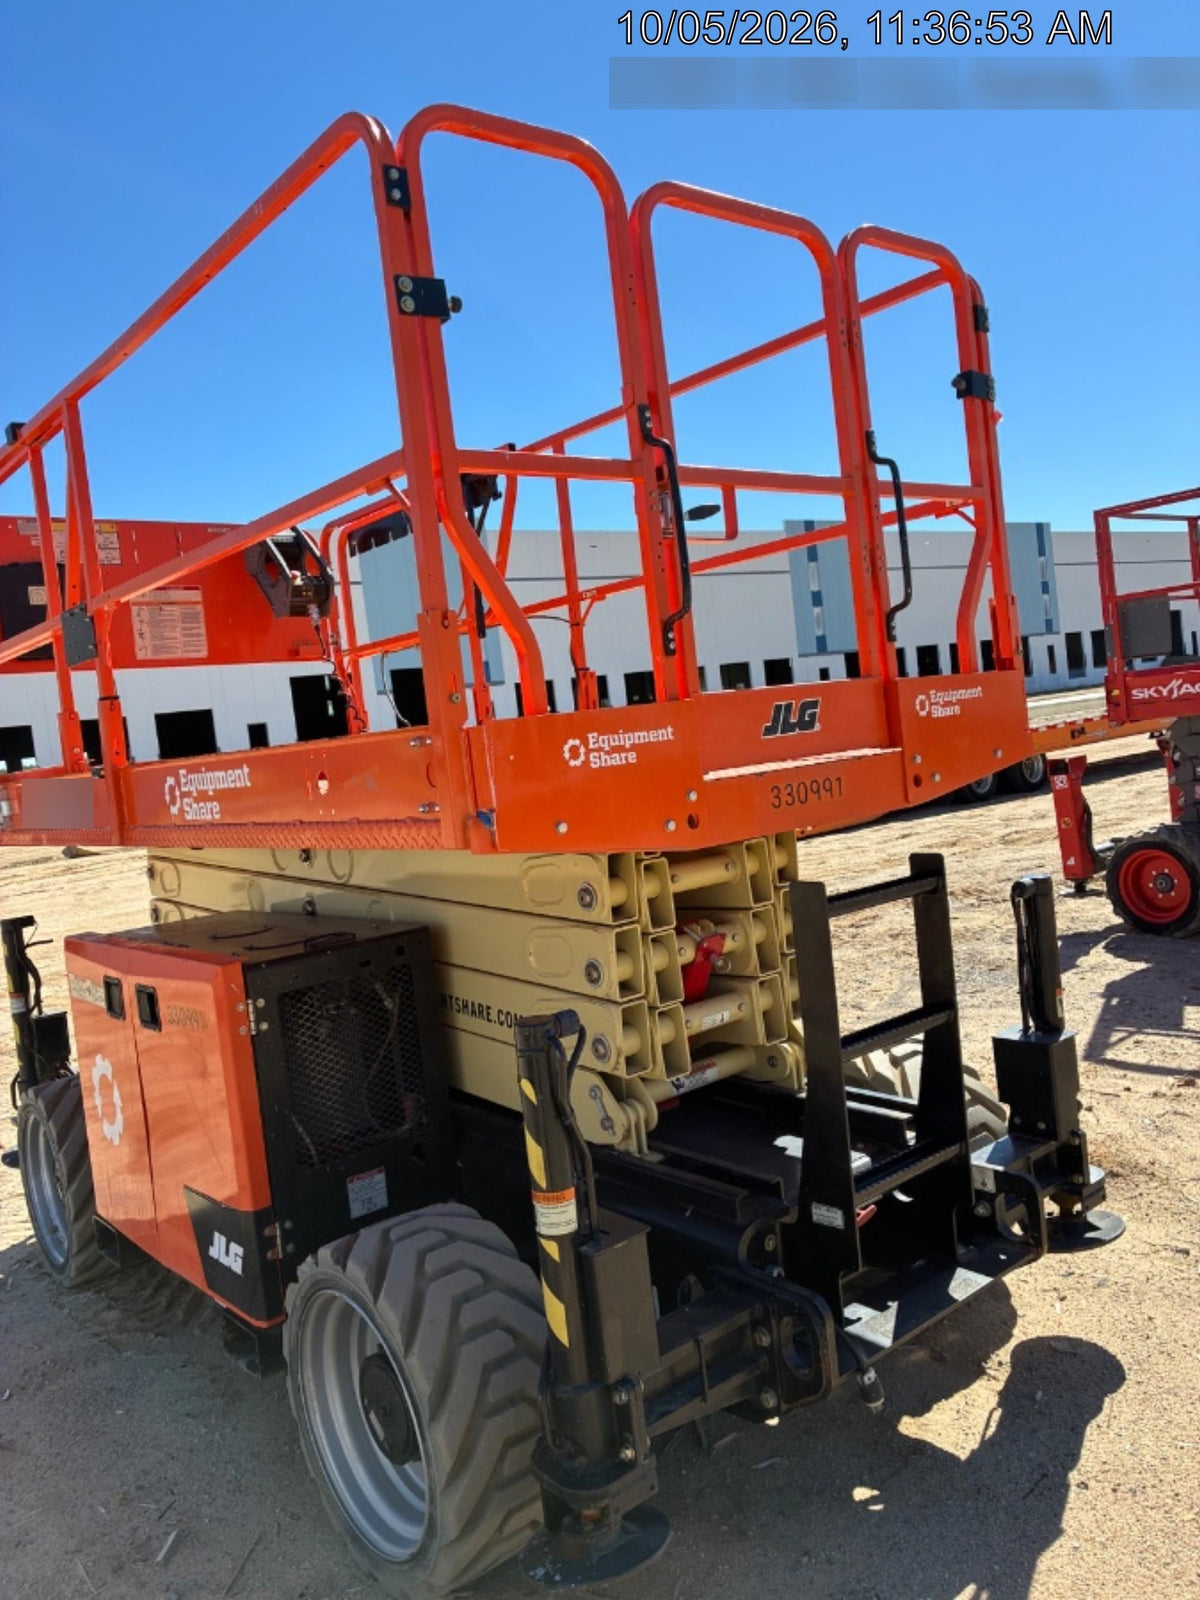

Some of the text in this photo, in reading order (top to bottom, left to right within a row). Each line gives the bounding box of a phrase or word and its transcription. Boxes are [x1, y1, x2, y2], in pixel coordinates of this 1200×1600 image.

[930, 686, 983, 704] Equipment
[762, 698, 821, 739] JLG
[931, 705, 961, 718] Share
[587, 725, 674, 750] Equipment
[589, 751, 637, 768] Share
[179, 764, 251, 796] Equipment
[770, 776, 843, 810] 330991
[182, 797, 221, 820] Share
[208, 1230, 244, 1275] JLG
